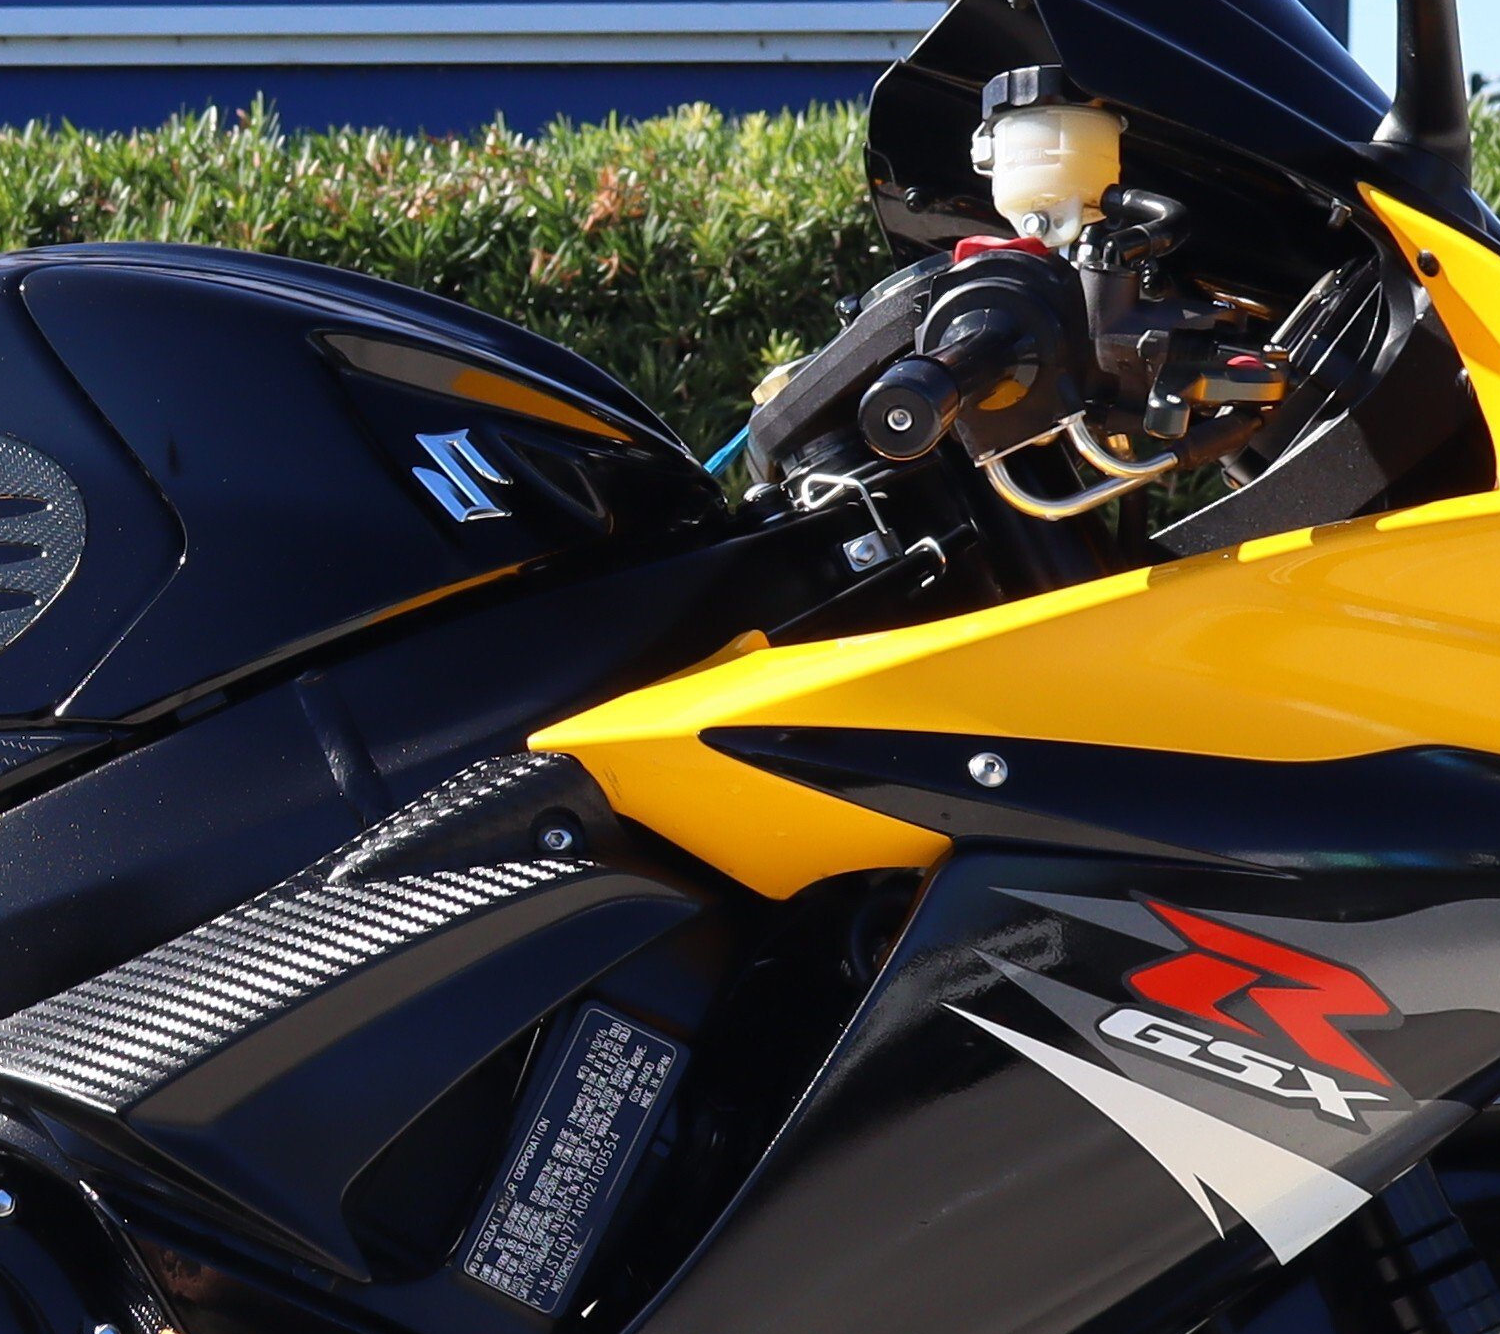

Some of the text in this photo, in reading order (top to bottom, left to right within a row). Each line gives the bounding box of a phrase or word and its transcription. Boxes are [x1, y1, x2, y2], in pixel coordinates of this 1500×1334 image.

[1099, 1008, 1389, 1122] GSX
[511, 1116, 551, 1182] CORPORATION
[549, 1239, 583, 1294] MOTORCYCLE
